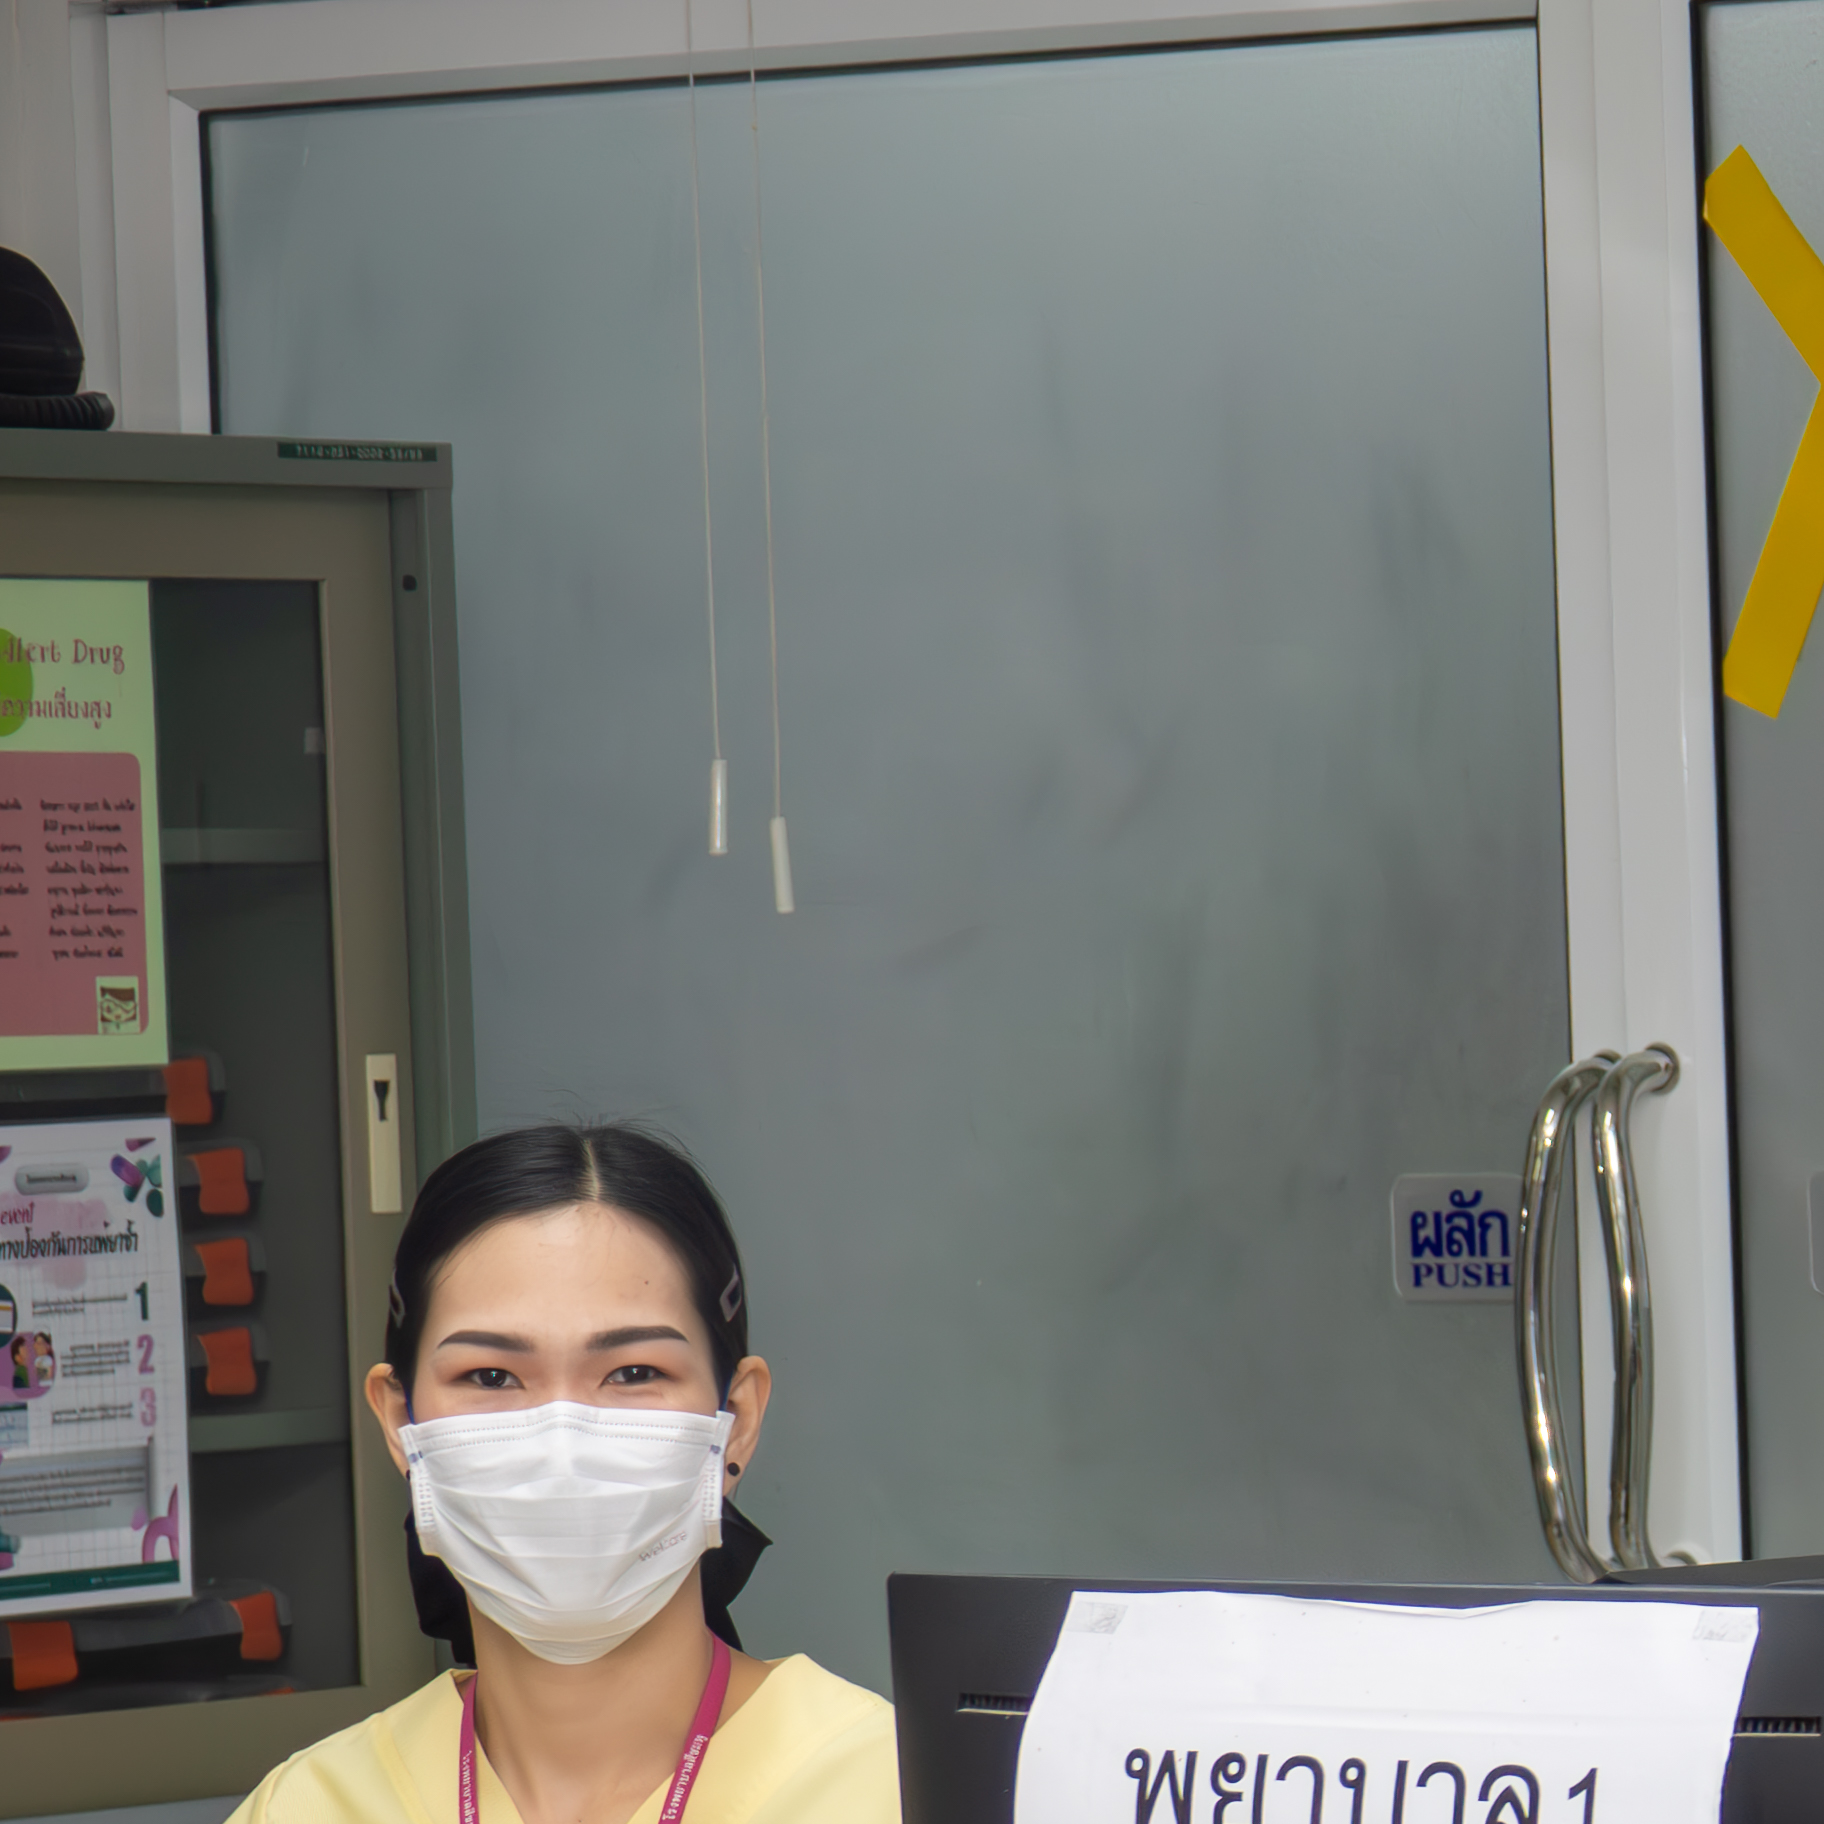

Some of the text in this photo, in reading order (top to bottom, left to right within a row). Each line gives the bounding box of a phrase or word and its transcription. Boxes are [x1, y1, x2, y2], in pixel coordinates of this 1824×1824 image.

[72, 638, 125, 675] Drug
[1410, 1189, 1511, 1258] ผลัก
[1411, 1262, 1513, 1288] PUSH
[135, 1281, 148, 1321] 1
[137, 1334, 155, 1374] 2
[139, 1387, 157, 1427] 3
